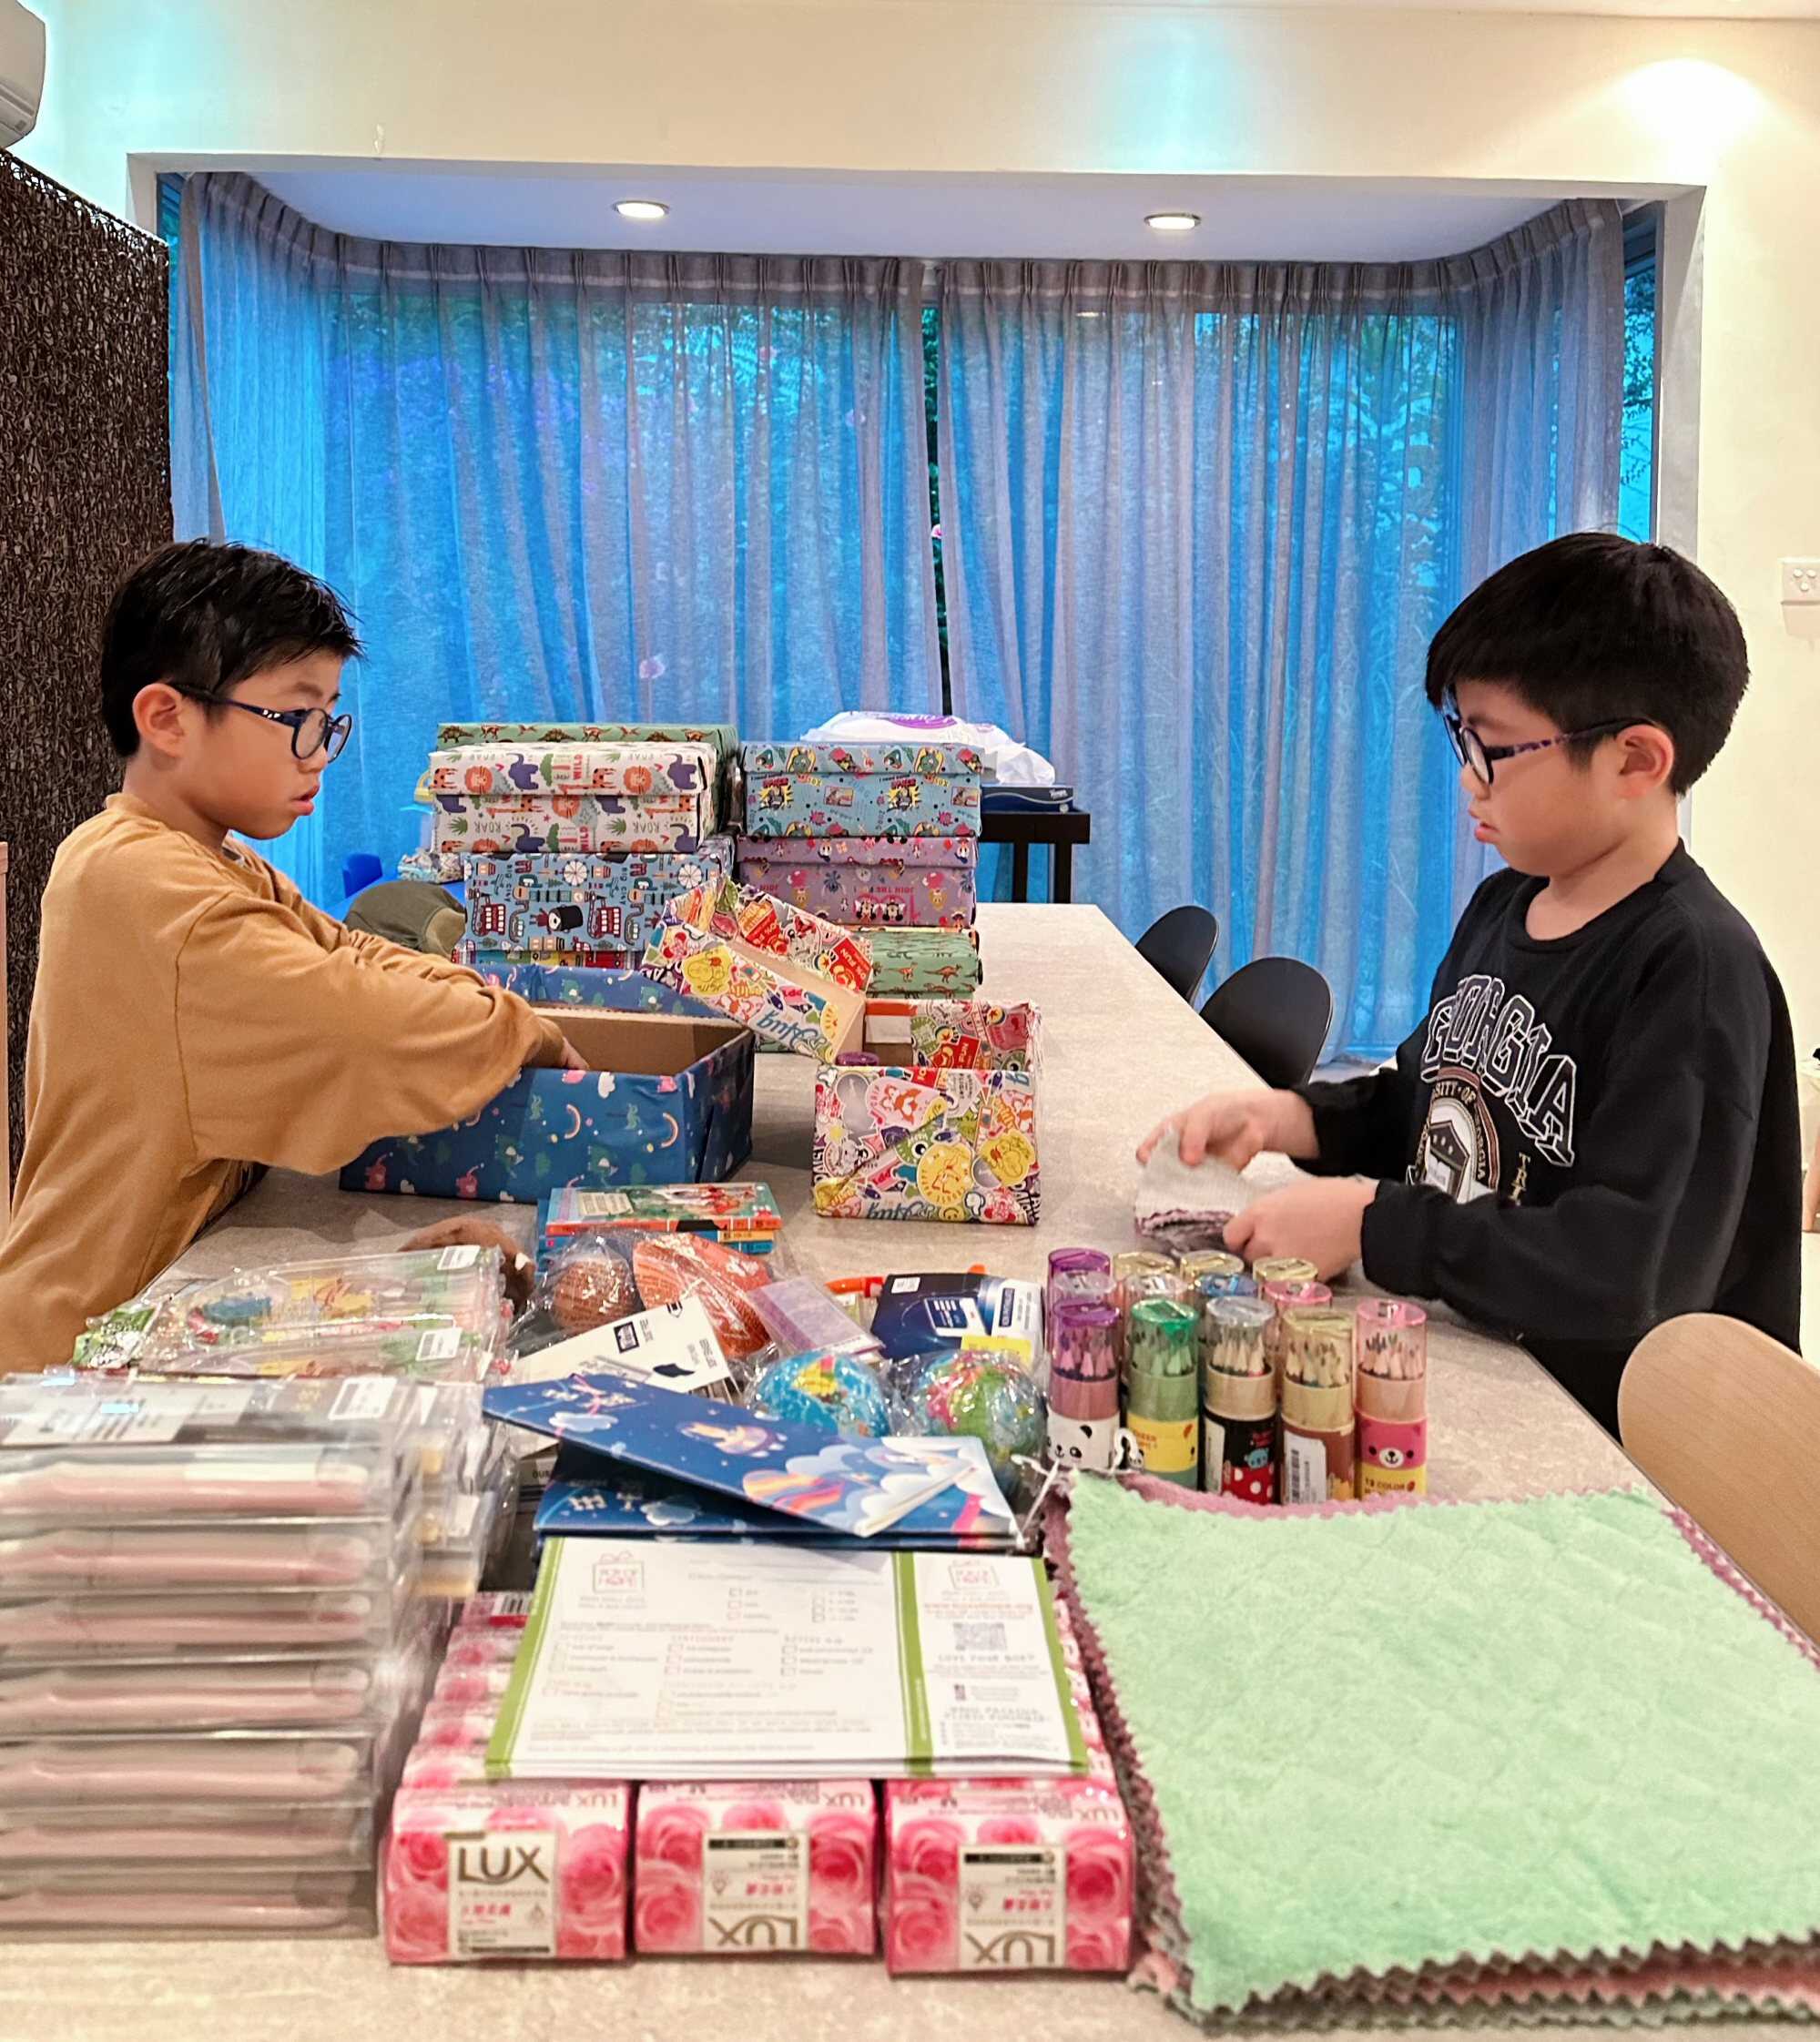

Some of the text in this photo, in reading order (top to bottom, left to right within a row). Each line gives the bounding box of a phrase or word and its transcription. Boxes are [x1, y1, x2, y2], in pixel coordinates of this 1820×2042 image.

[821, 1792, 865, 1808] LUX
[457, 1845, 550, 1885] LUX
[708, 1914, 798, 1947] LUX
[965, 1929, 1056, 1965] LUX
